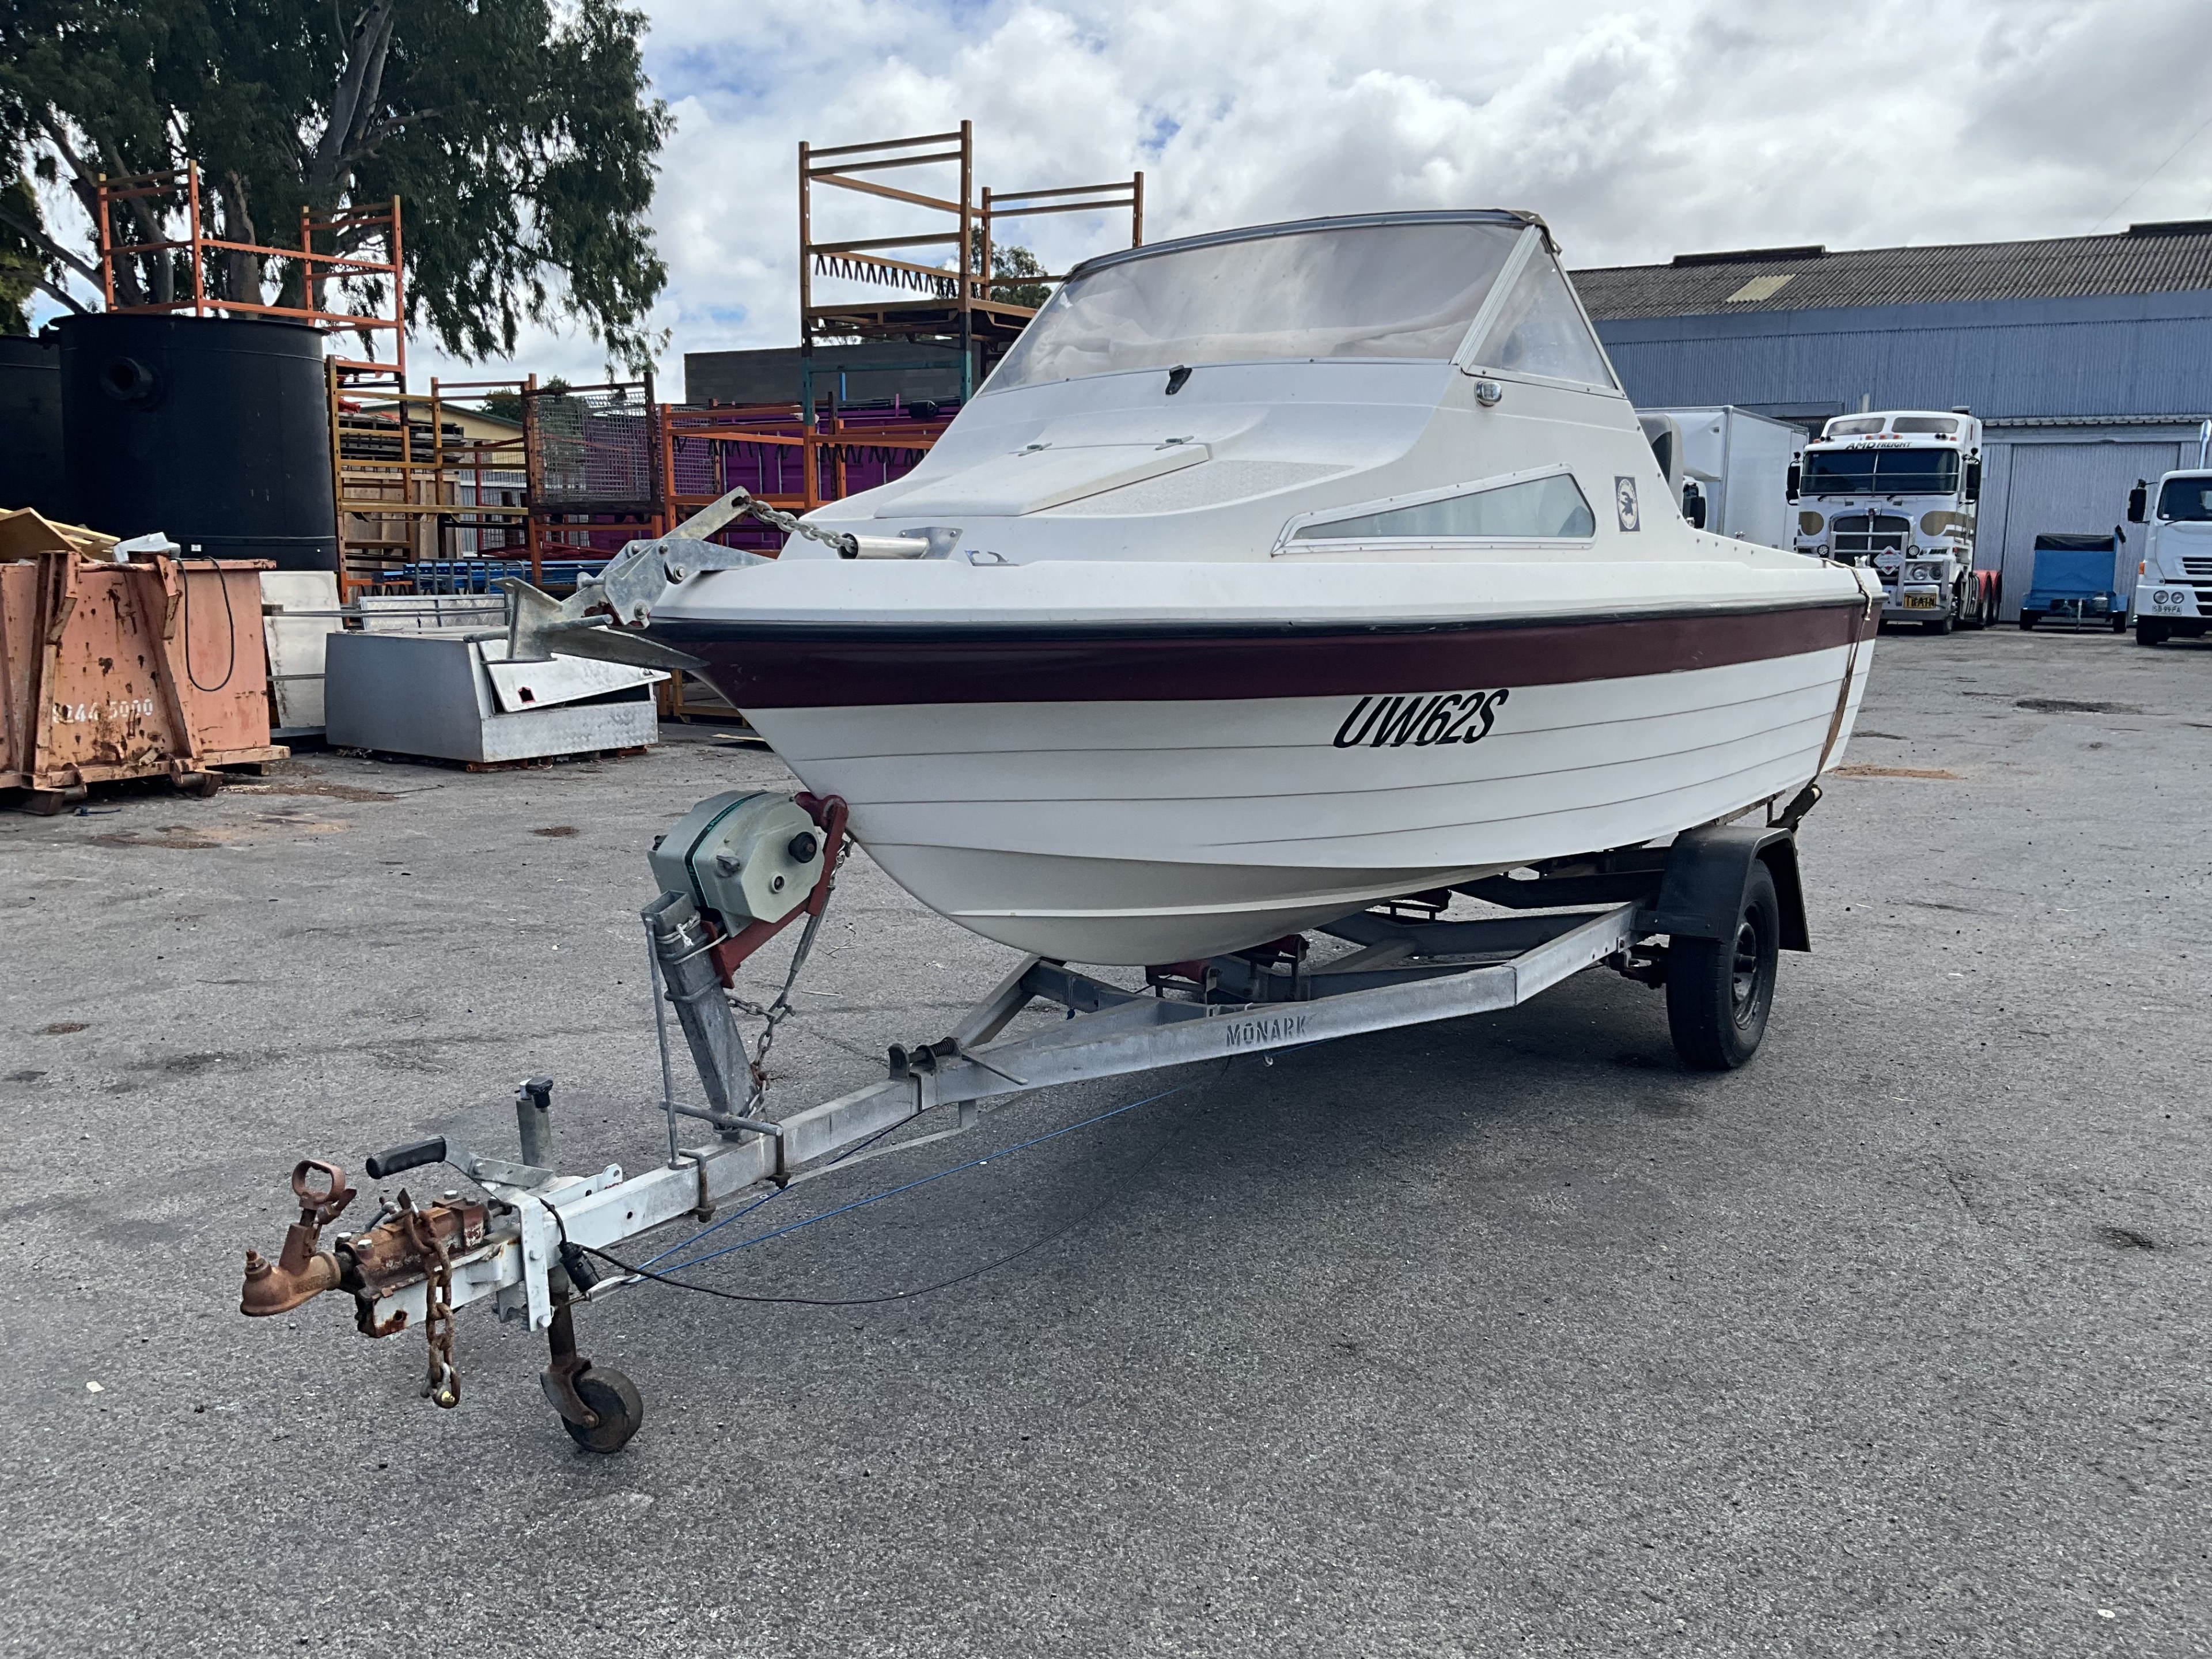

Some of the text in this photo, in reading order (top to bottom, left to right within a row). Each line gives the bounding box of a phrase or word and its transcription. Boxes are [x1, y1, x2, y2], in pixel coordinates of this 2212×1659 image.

[108, 698, 153, 719] 5000
[1333, 688, 1509, 748] UW62S
[1226, 1016, 1306, 1047] MONARK
